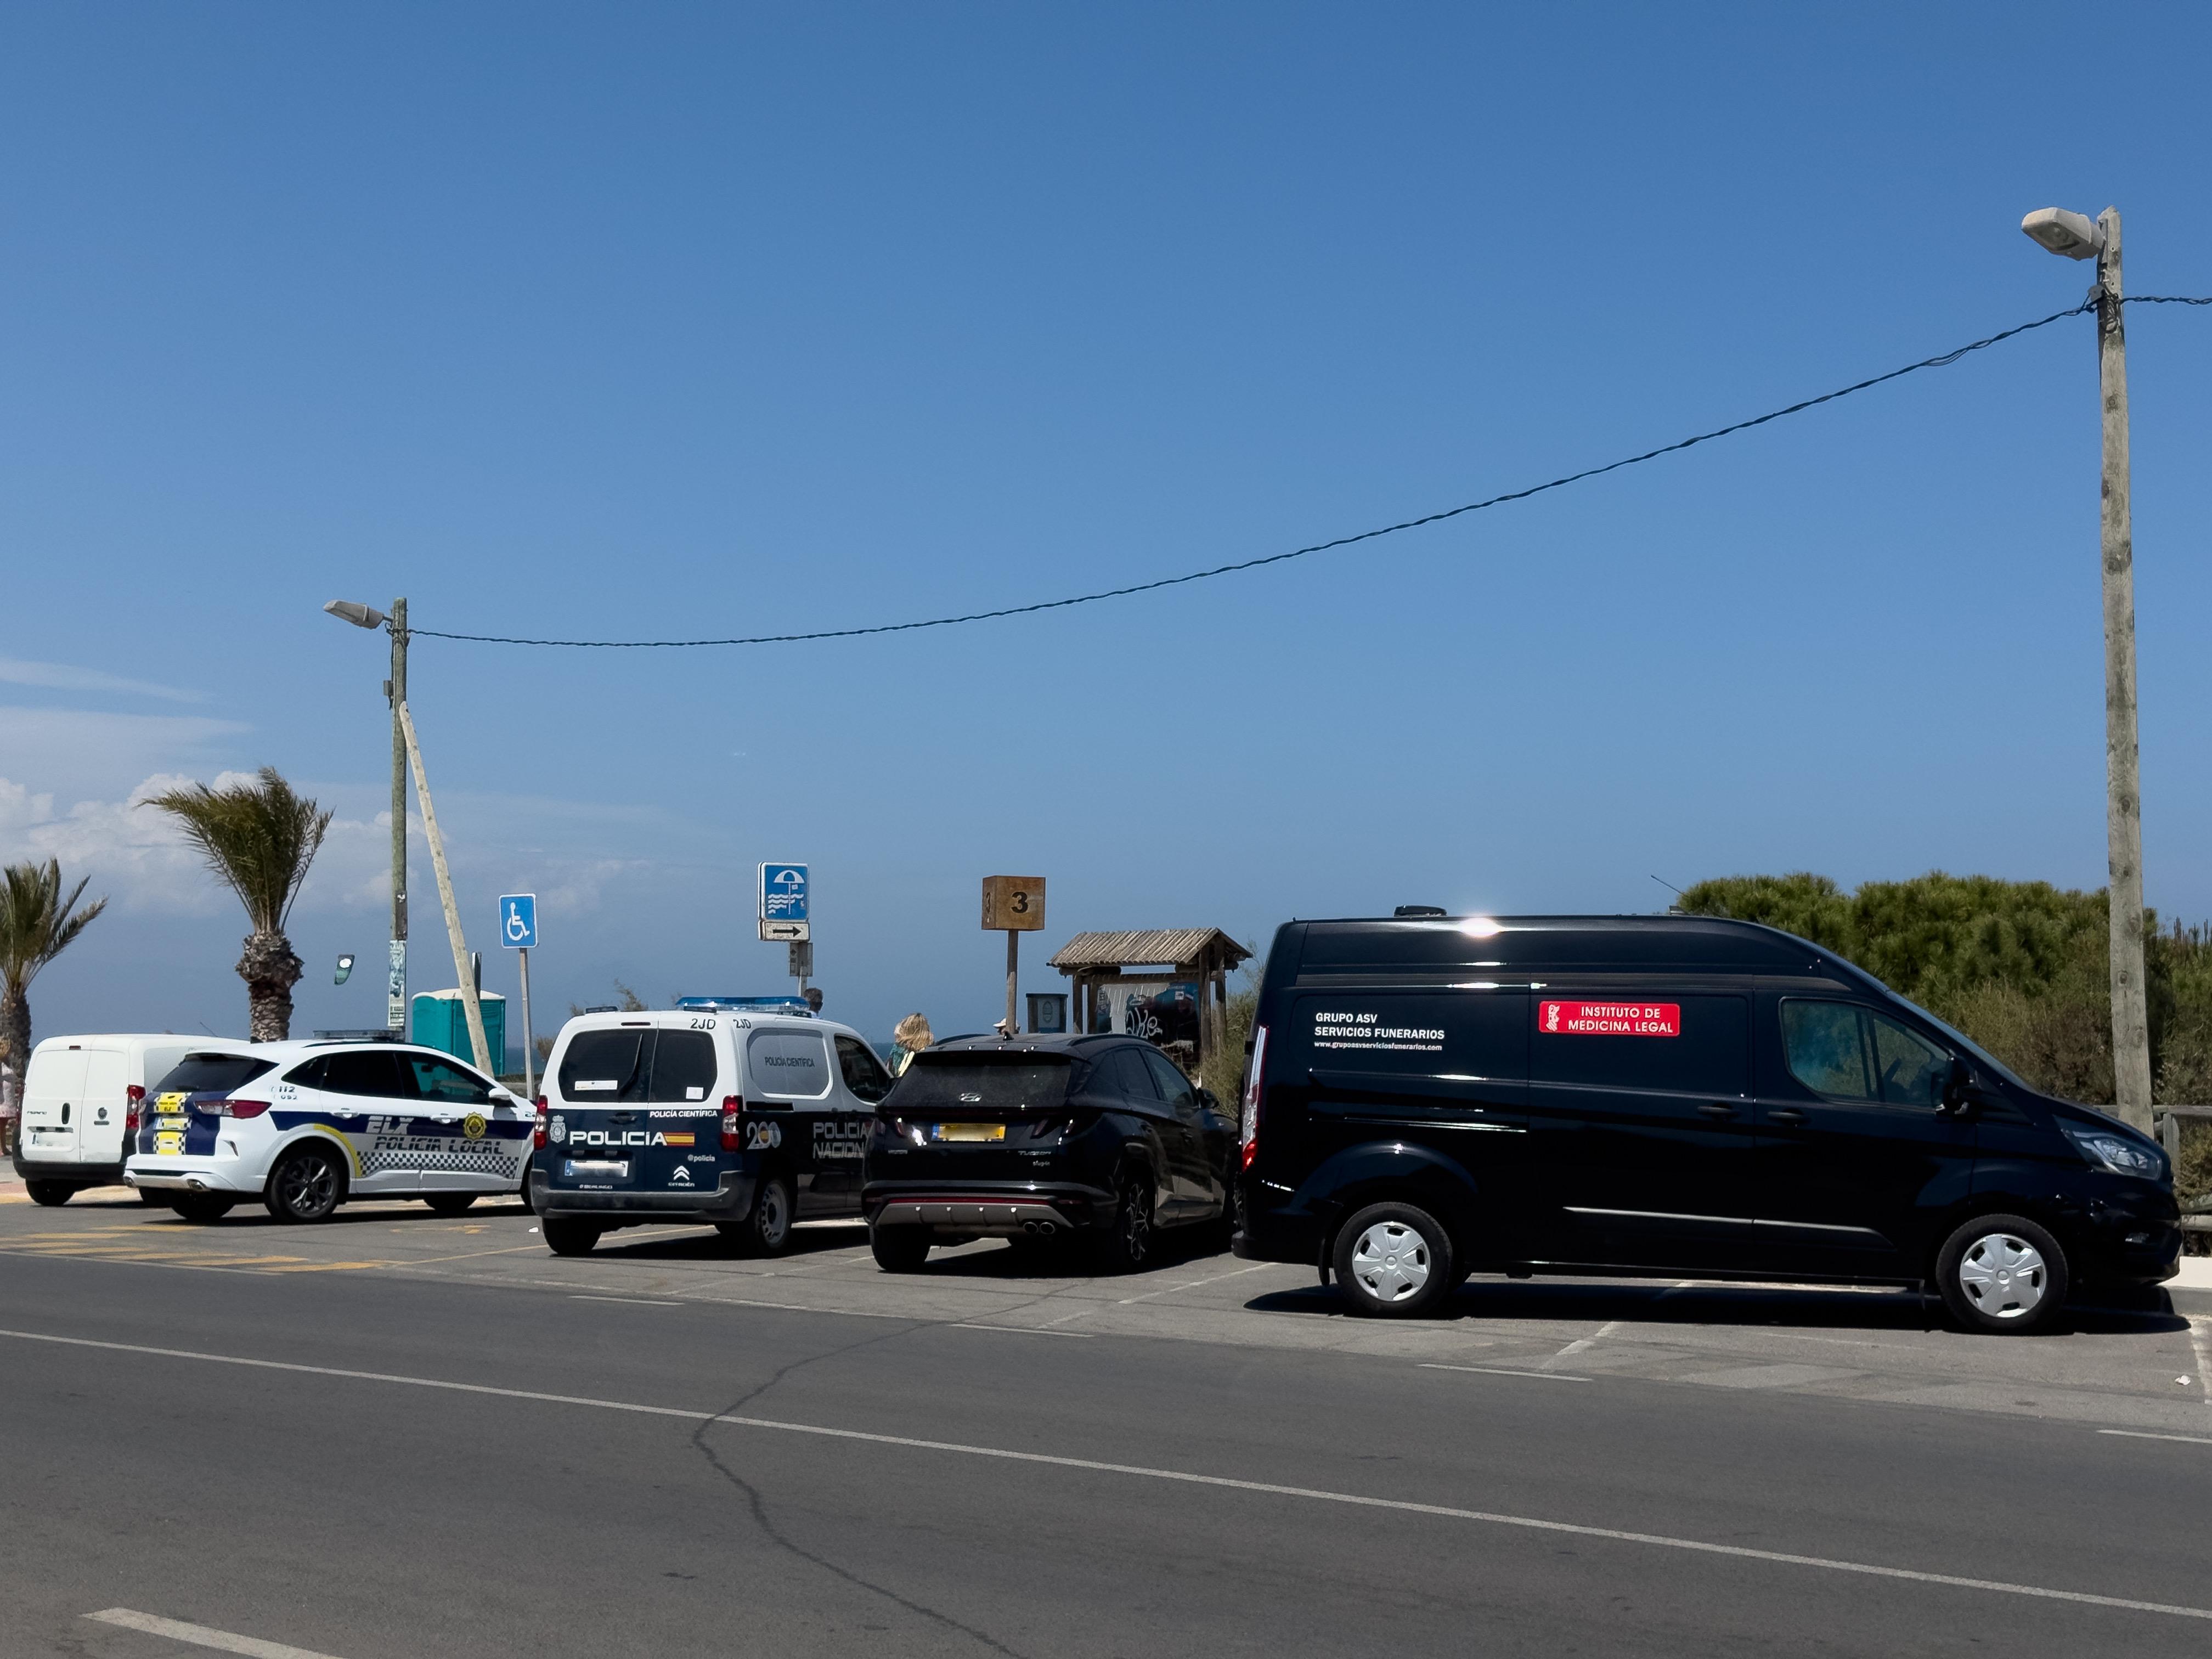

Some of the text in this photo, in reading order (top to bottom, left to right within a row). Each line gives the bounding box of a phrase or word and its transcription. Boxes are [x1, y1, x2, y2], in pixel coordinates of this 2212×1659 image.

[1011, 891, 1029, 913] 3
[1316, 1013, 1378, 1023] GRUPO ASV
[1581, 1006, 1661, 1018] INSTITUTO DE
[690, 1018, 716, 1030] 2JD
[733, 1019, 751, 1029] 2JD
[1568, 1020, 1673, 1032] MEDICINA LEGAL
[1314, 1027, 1445, 1039] SERVICIOS FUNERARIOS
[650, 1108, 718, 1118] POLICÍA CIENTÍFICA
[366, 1115, 414, 1135] ELX
[448, 1139, 504, 1154] LOCAL
[813, 1141, 865, 1159] NACION
